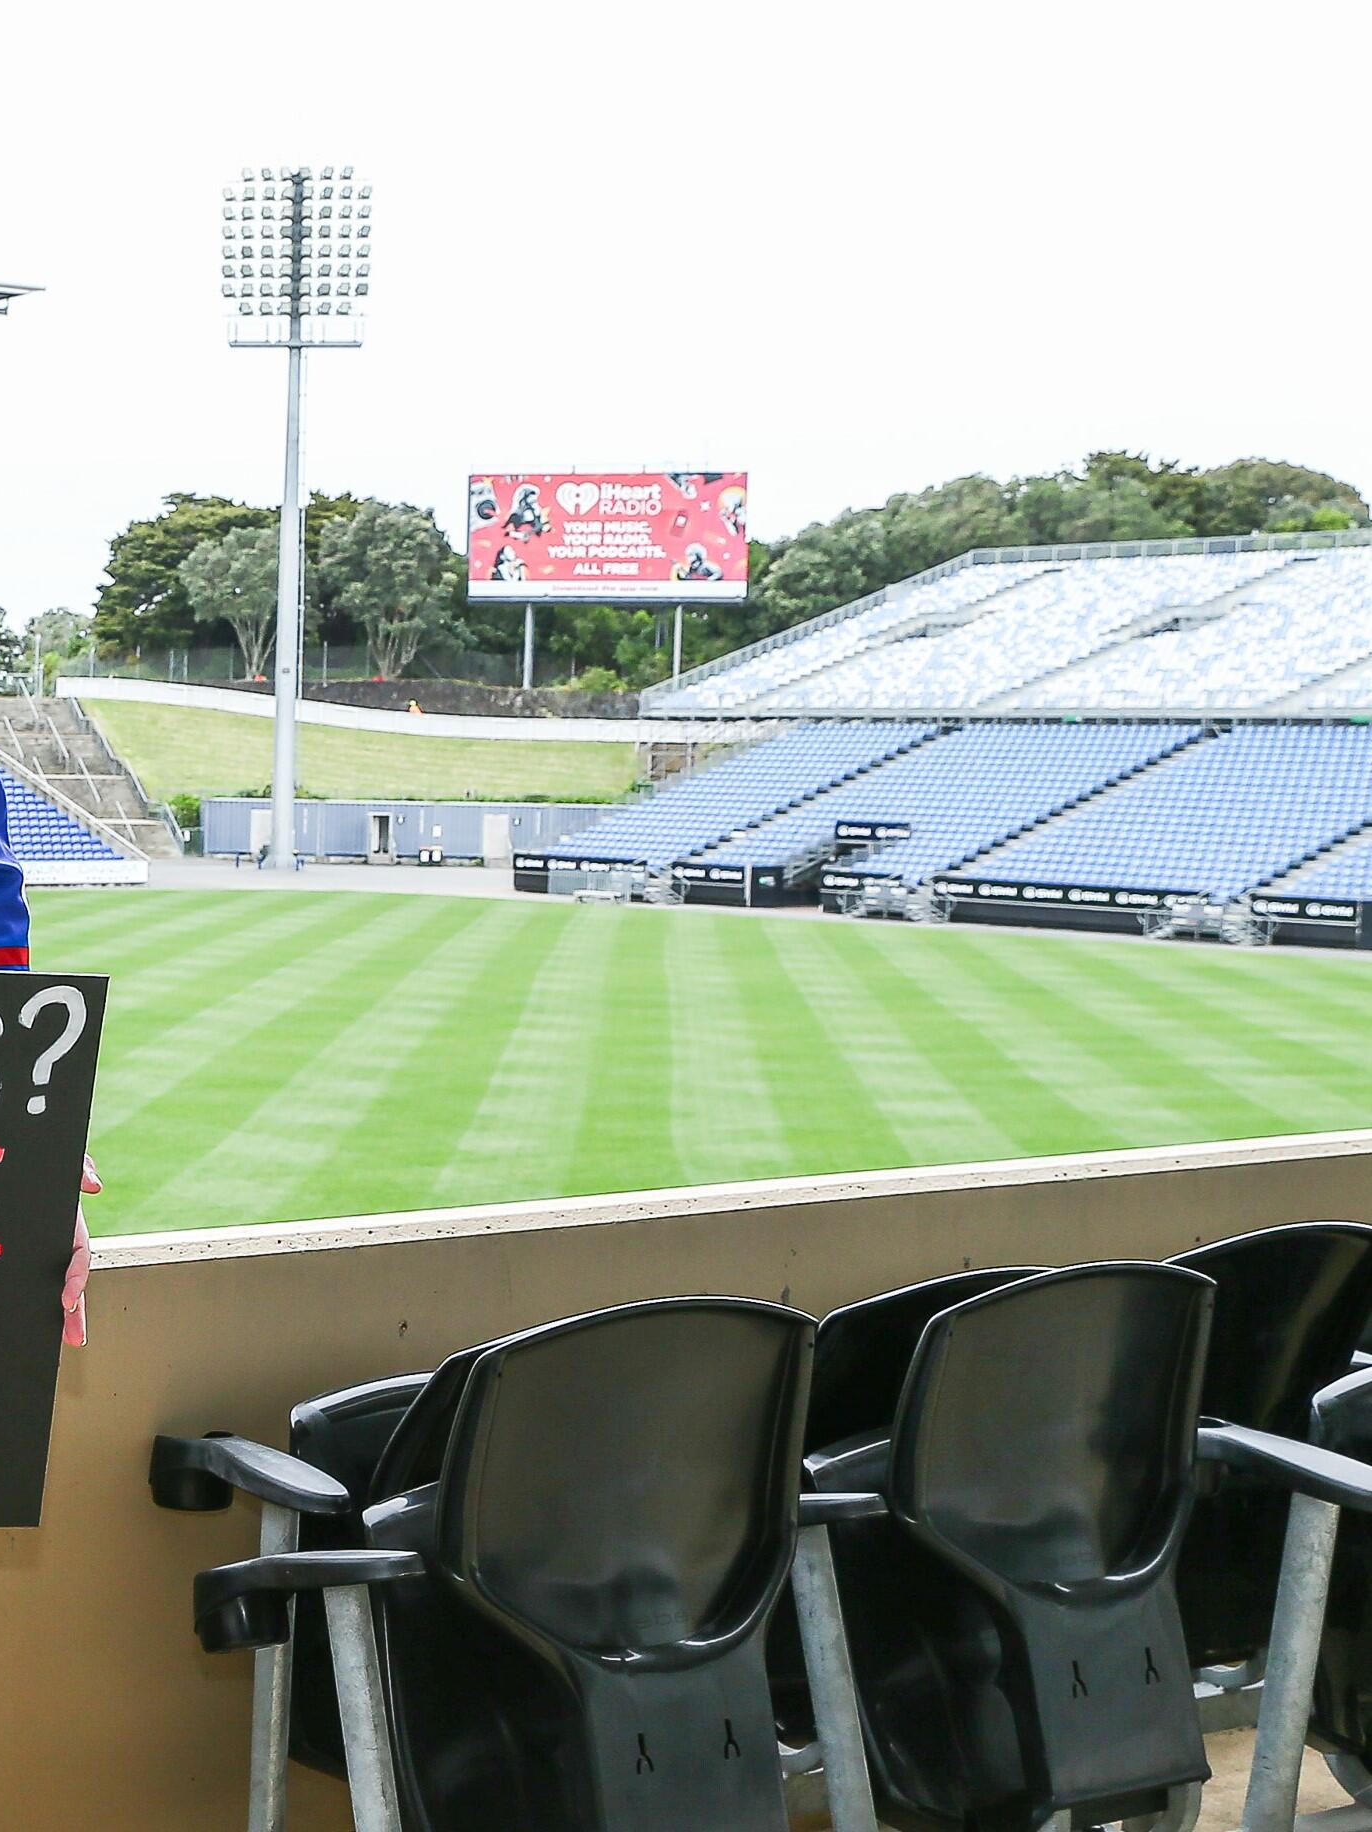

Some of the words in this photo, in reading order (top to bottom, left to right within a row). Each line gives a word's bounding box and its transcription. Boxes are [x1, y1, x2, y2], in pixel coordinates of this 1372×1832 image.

[600, 483, 662, 500] iHeart
[599, 500, 662, 516] RADIO
[563, 521, 602, 534] YOUR
[604, 521, 652, 534] MUSIC.
[562, 534, 602, 545] YOUR
[603, 534, 652, 545] RADIO.
[548, 546, 586, 558] YOUR
[573, 562, 601, 575] ALL
[602, 562, 639, 575] FREE
